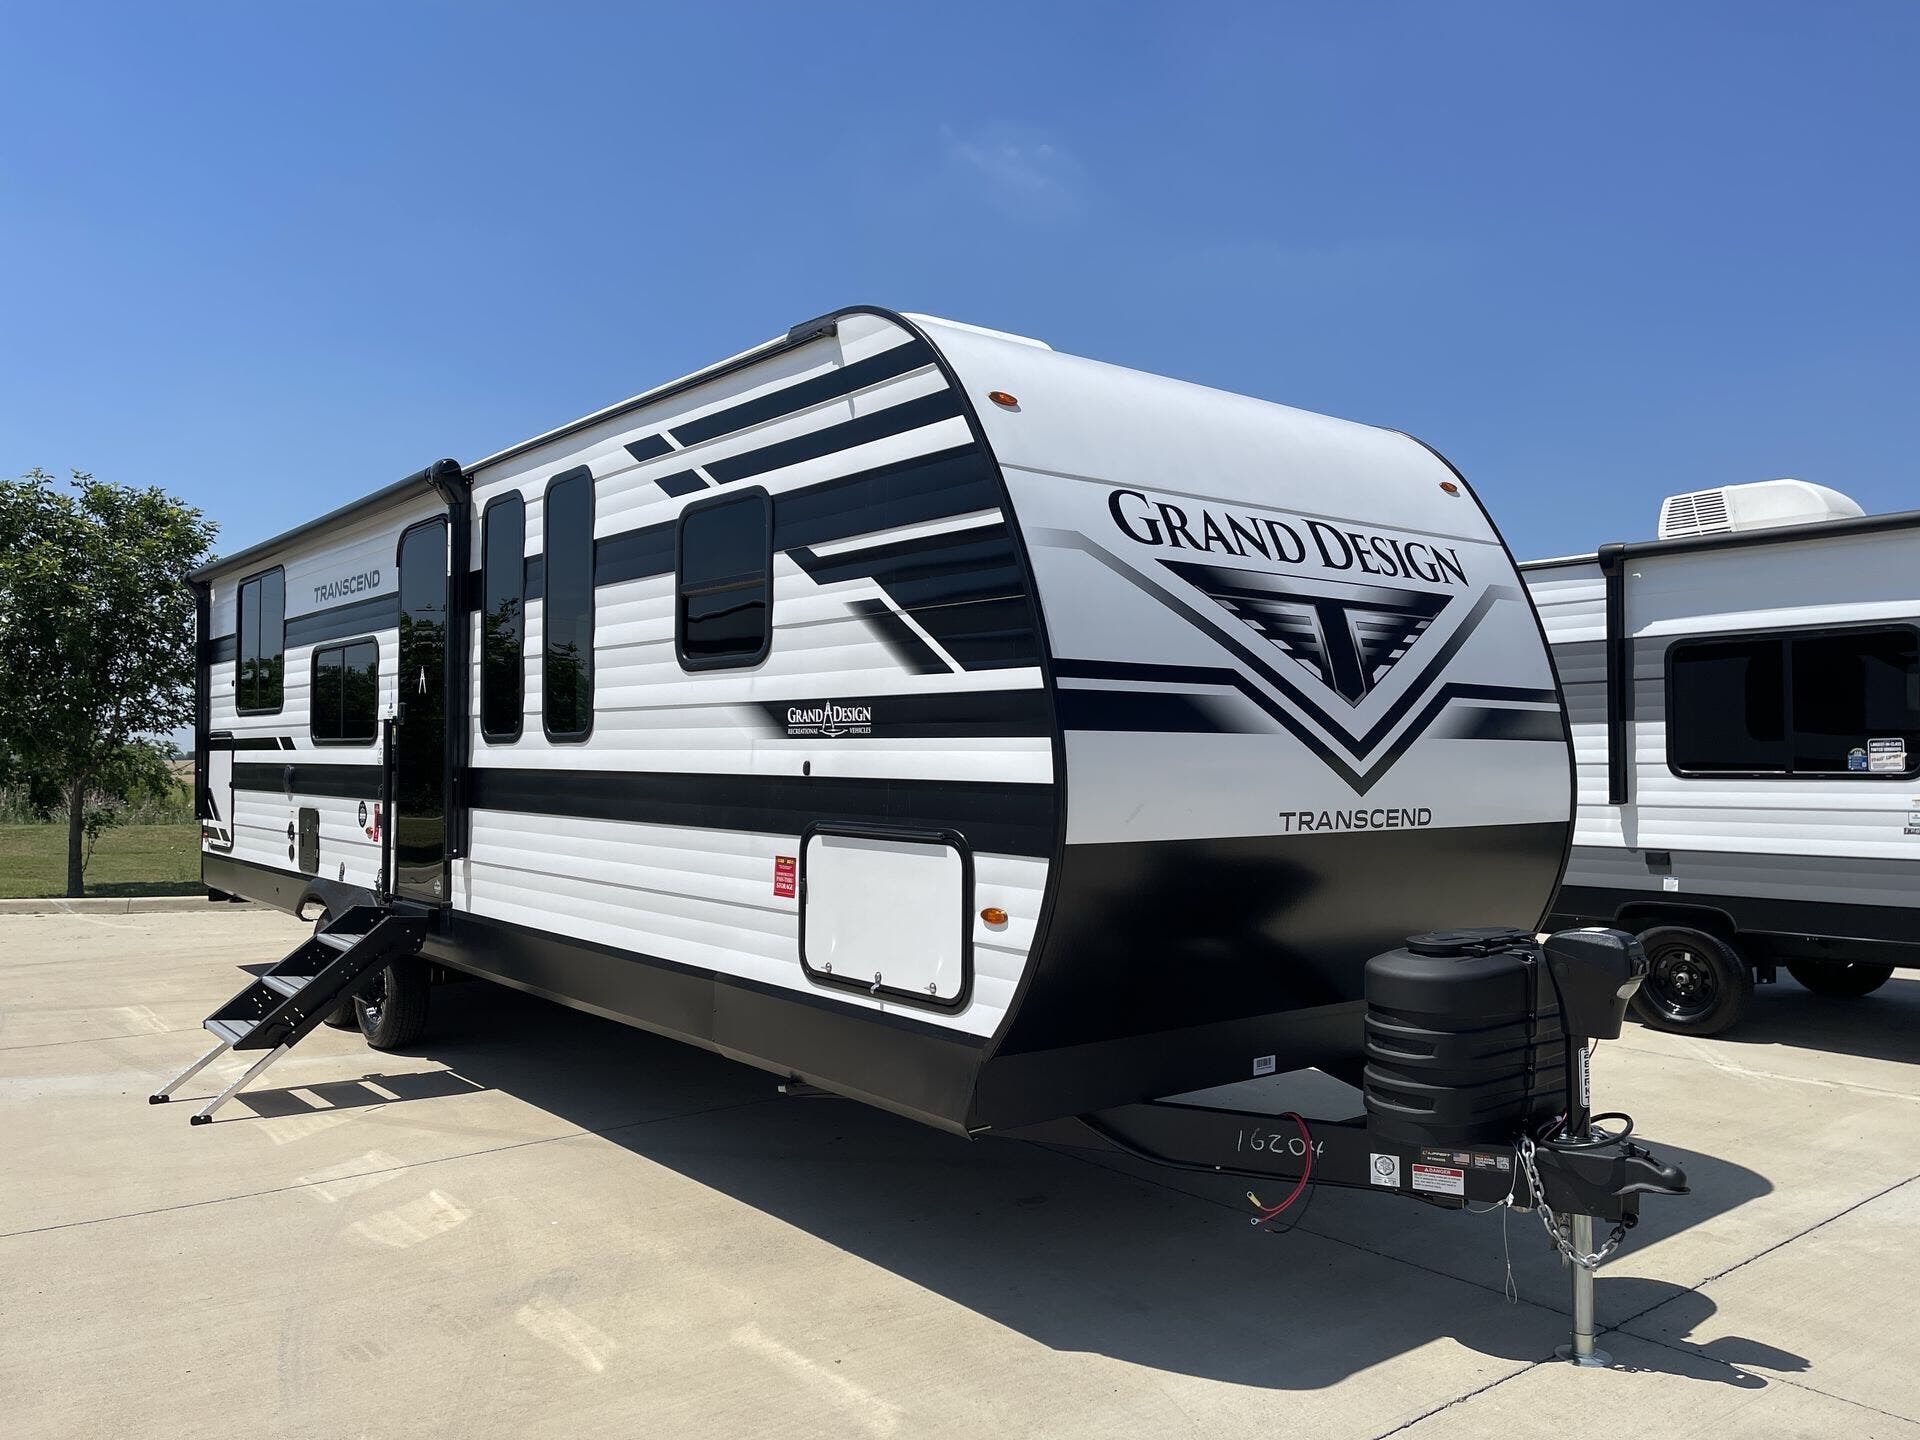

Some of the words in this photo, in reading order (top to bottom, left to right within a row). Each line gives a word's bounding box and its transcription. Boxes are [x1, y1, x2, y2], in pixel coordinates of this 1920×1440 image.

[1107, 488, 1307, 564] GRAND
[1300, 518, 1470, 588] DESIGN
[313, 569, 381, 604] TRANSCEND
[787, 707, 824, 724] GRAND
[832, 705, 872, 722] DESIGN
[787, 727, 819, 735] RECREATIONAL
[849, 726, 872, 734] VEHICLES
[1279, 807, 1433, 832] TRANSCEND
